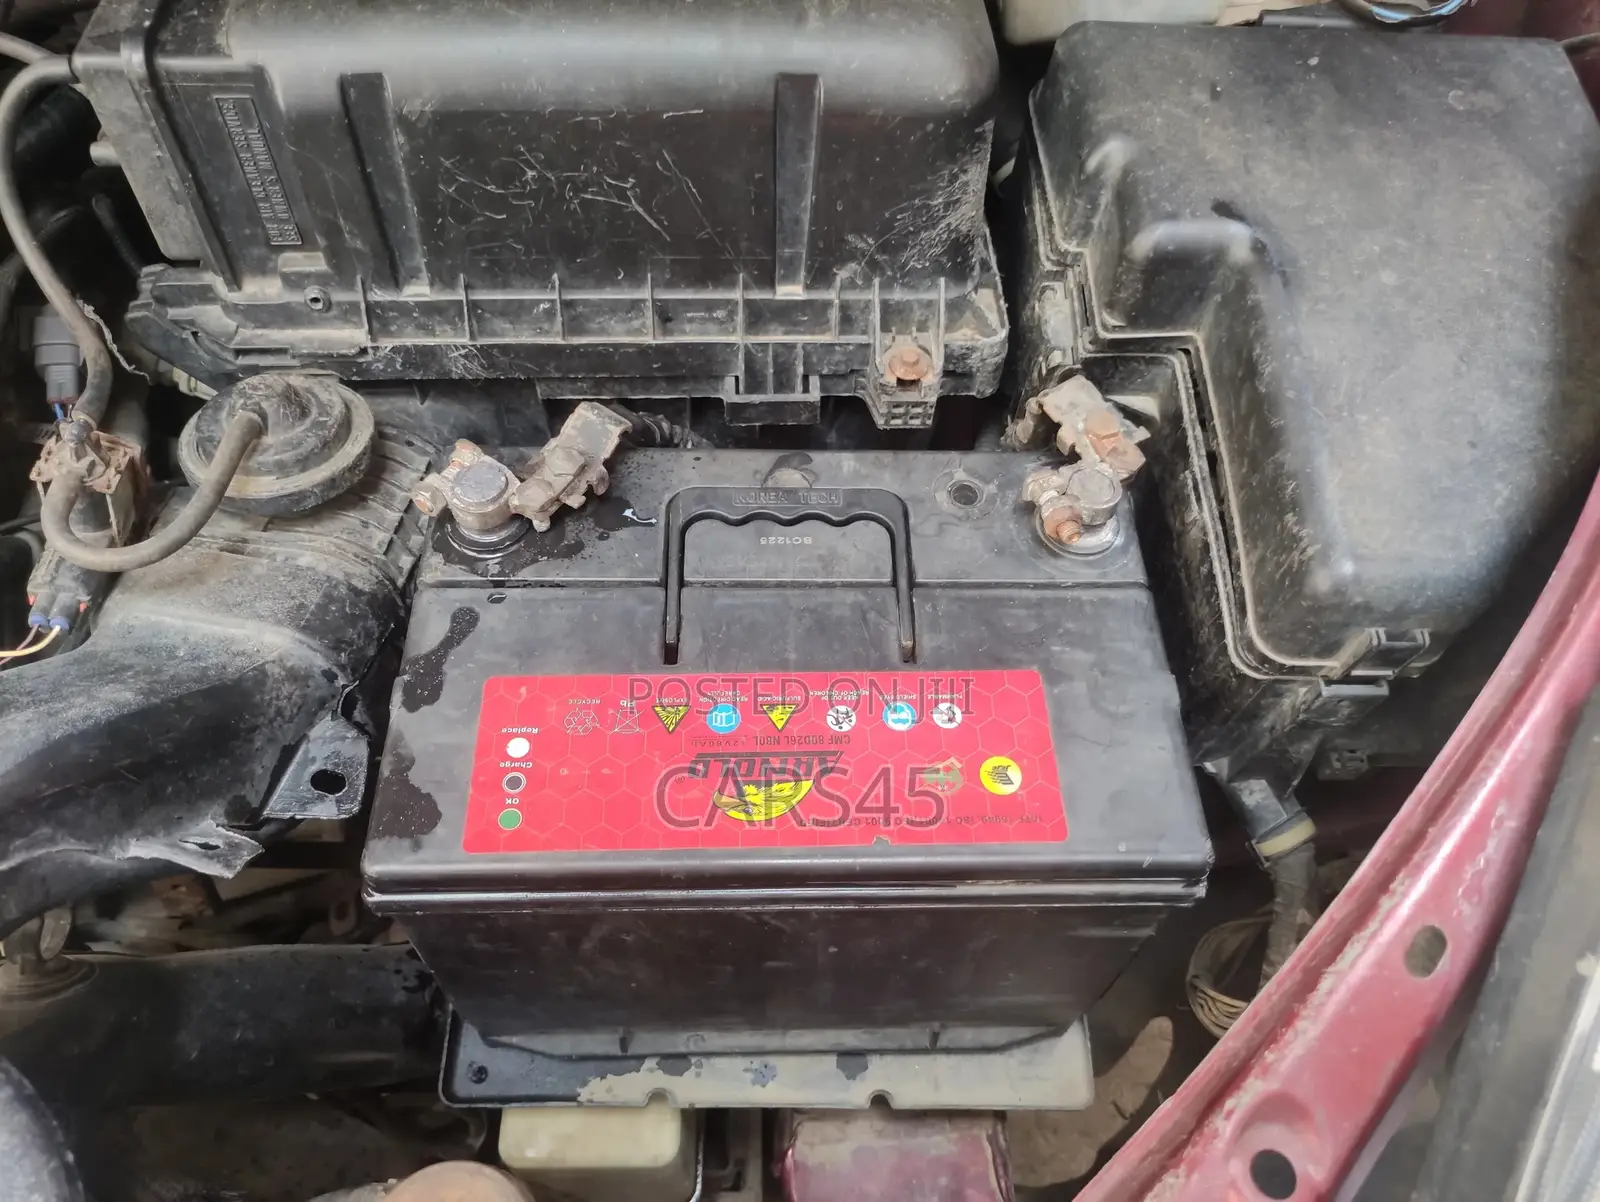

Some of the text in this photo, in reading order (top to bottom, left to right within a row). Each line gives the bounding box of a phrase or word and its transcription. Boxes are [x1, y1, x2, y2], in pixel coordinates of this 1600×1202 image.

[239, 153, 267, 198] CLEANER
[258, 203, 276, 219] AIR
[266, 224, 283, 241] FOR
[281, 225, 299, 241] SEE
[736, 491, 838, 504] KOREA TECH
[760, 536, 812, 545] BC1225
[620, 700, 635, 708] Pb
[828, 734, 851, 745] CMF
[687, 754, 842, 779] ARNOLD
[505, 797, 520, 805] OK
